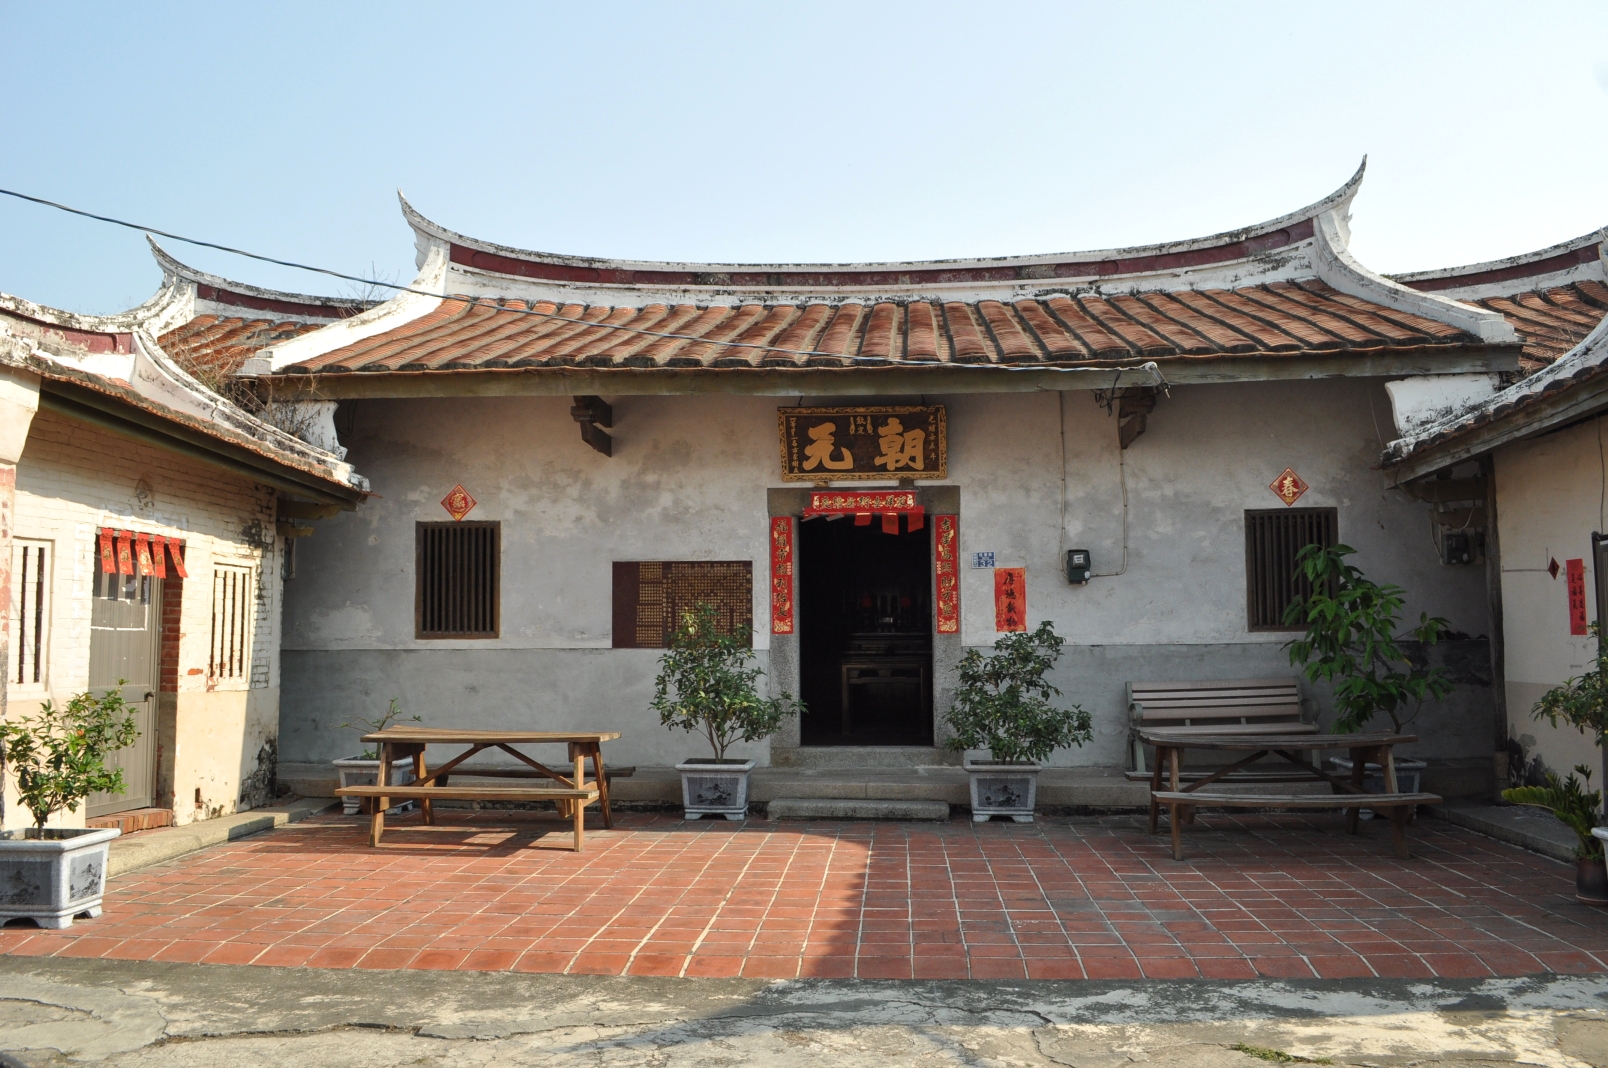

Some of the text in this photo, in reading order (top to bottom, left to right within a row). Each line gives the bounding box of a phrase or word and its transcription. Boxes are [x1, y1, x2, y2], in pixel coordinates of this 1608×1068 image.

[1280, 476, 1299, 497] 春
[1003, 571, 1018, 628] 厚德載物
